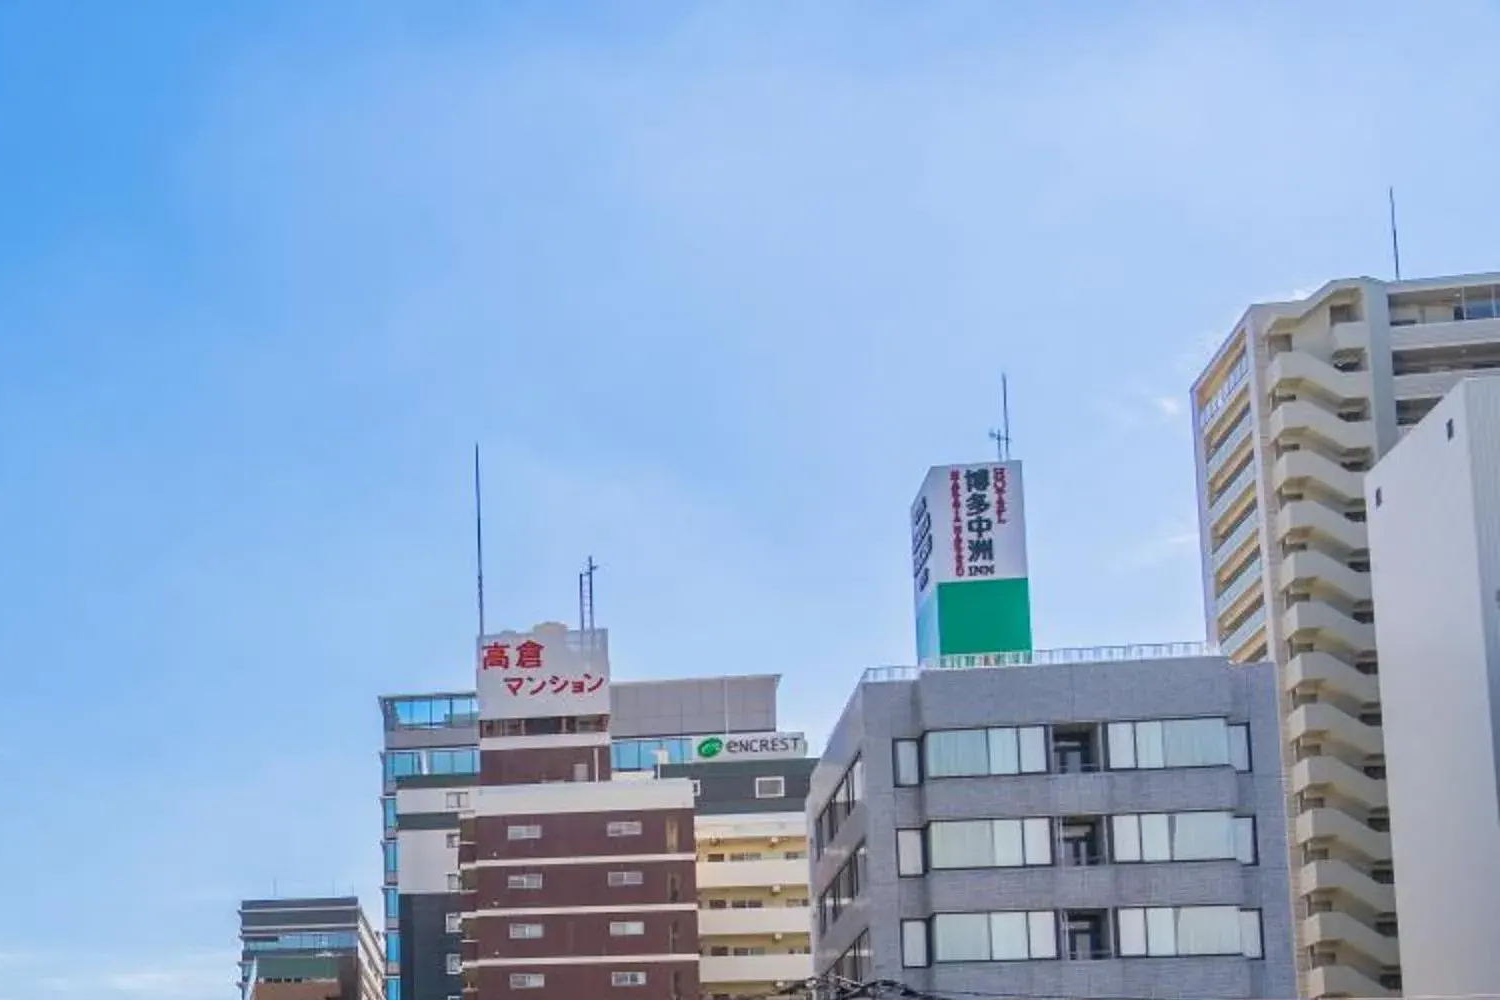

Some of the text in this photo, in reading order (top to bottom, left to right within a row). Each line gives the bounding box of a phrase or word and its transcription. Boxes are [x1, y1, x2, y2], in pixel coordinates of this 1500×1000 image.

[964, 468, 993, 562] 博多中洲
[481, 641, 544, 670] 高倉
[503, 673, 604, 696] マンション
